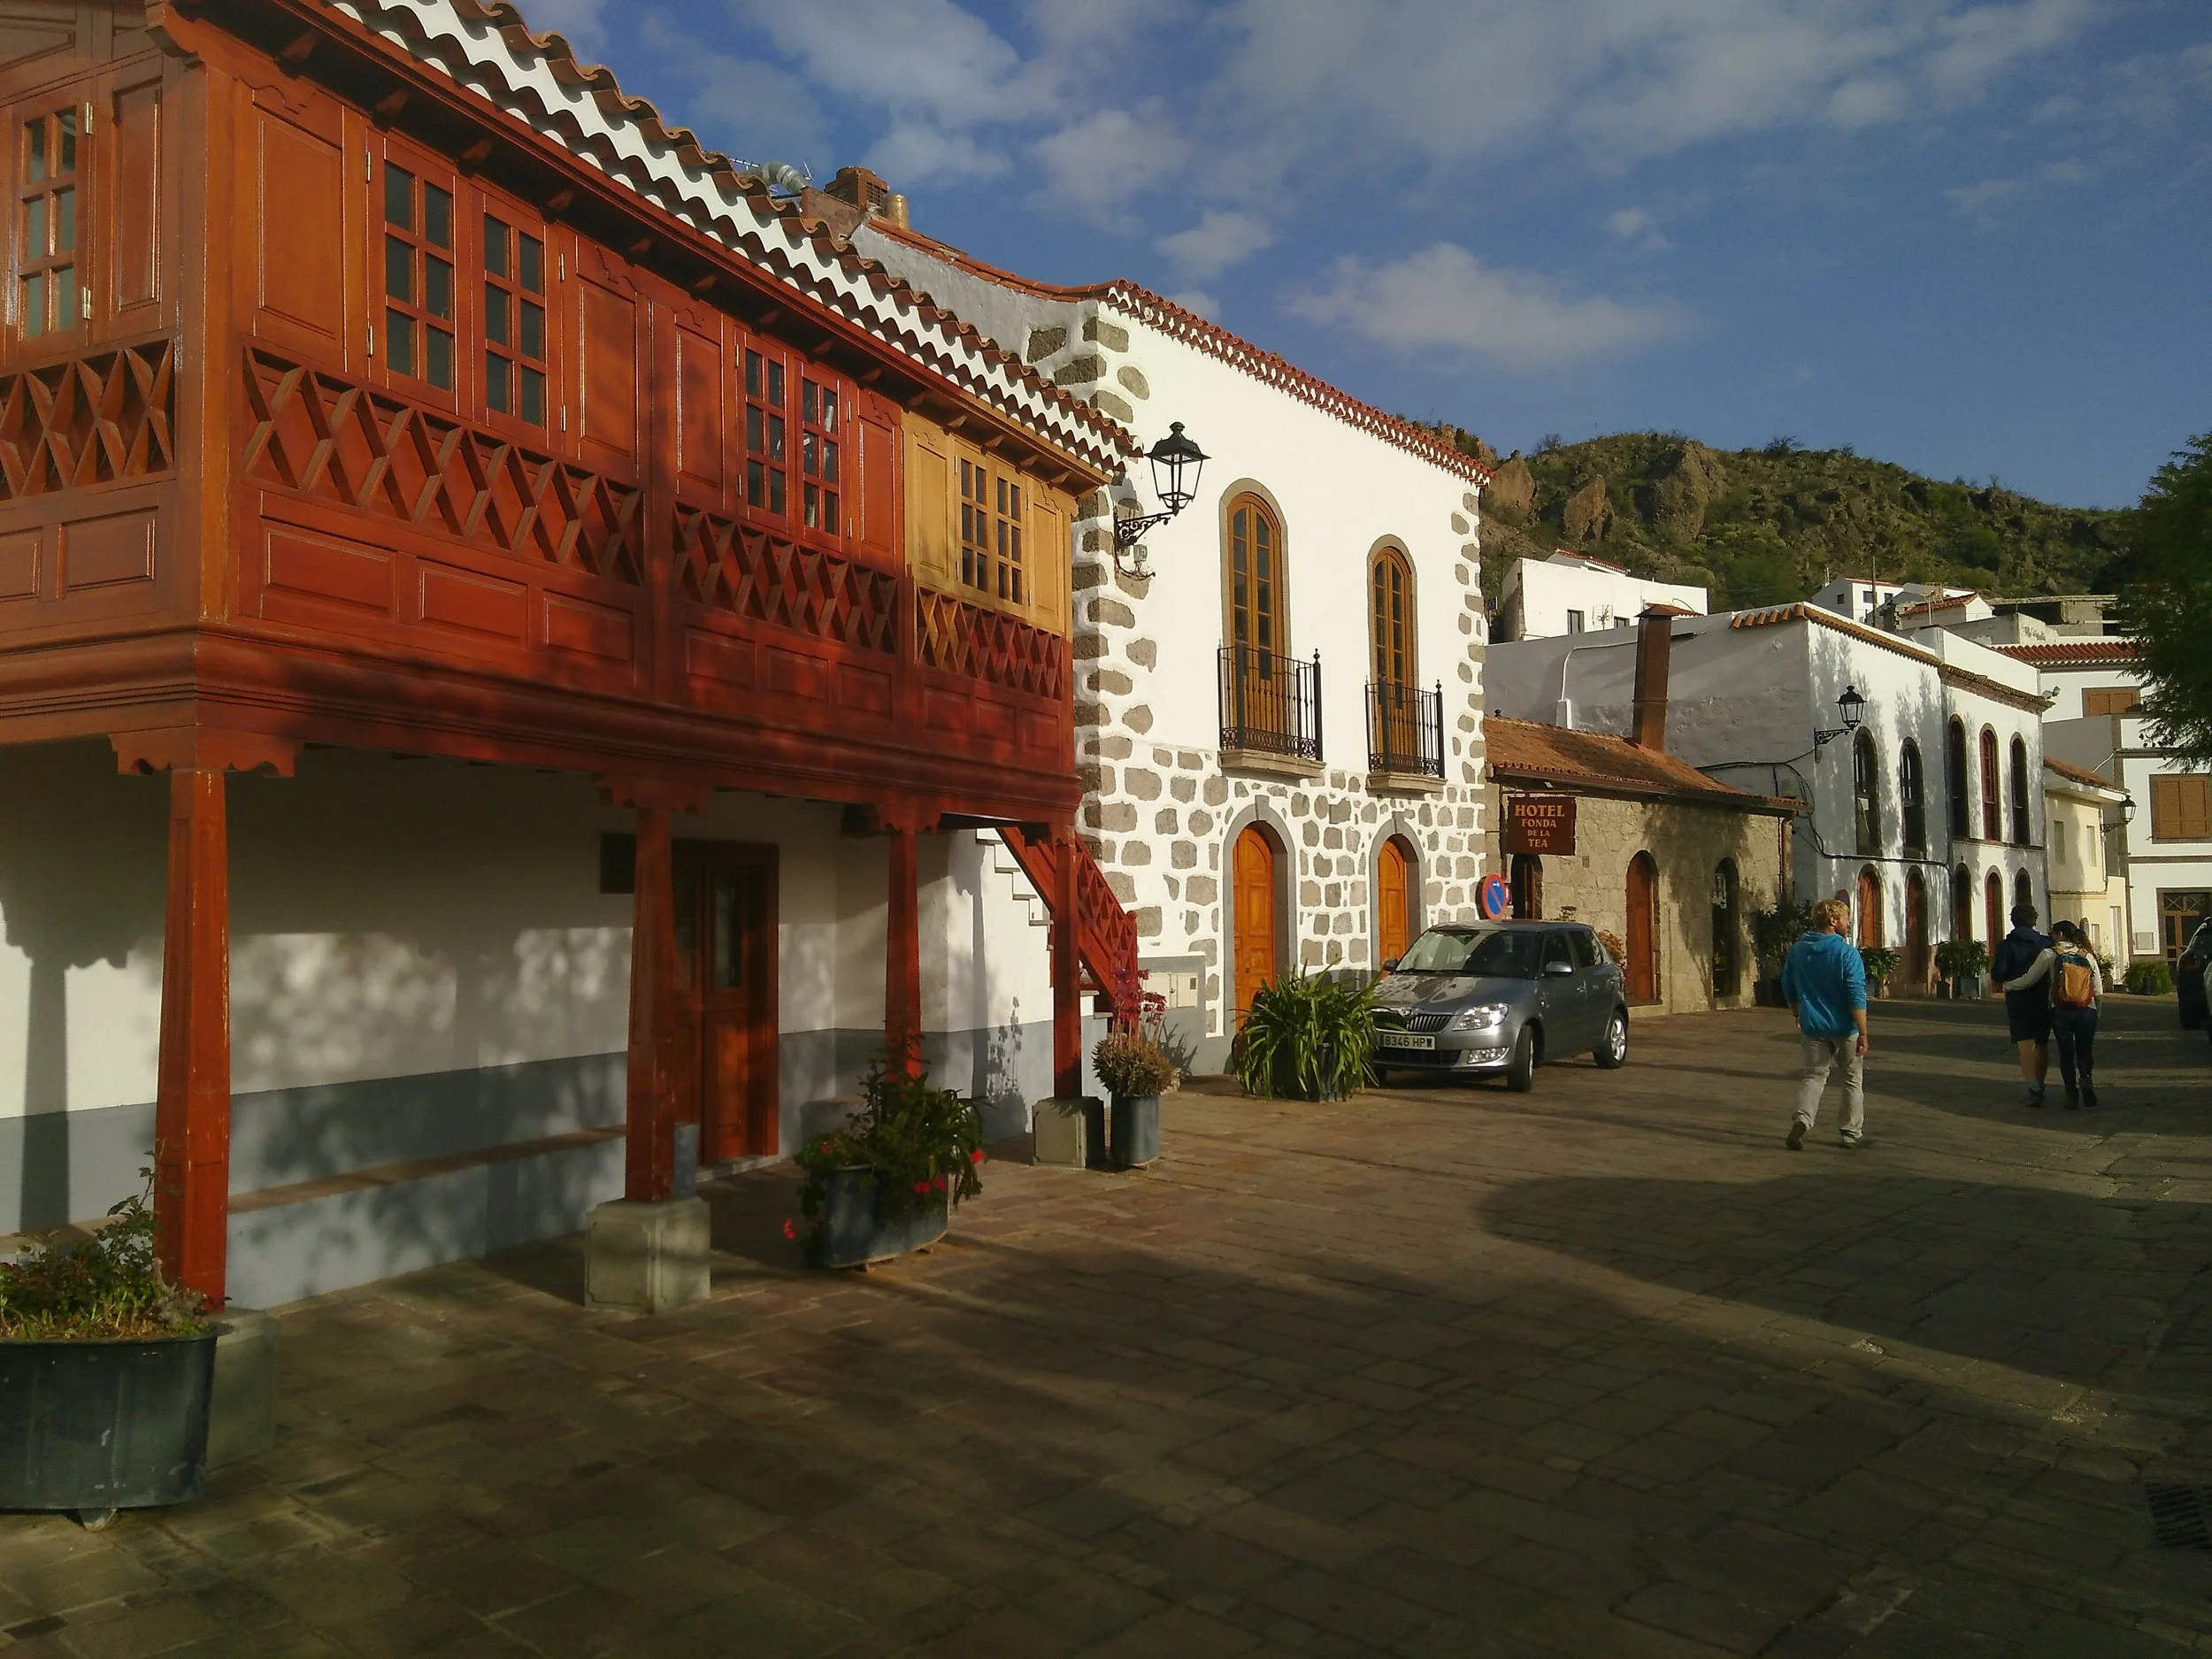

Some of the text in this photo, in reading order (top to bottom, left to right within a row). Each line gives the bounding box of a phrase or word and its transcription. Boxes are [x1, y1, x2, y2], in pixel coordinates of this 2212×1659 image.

[1515, 804, 1564, 818] HOTEL
[1521, 818, 1557, 828] FONDA
[1386, 1036, 1409, 1048] 8346
